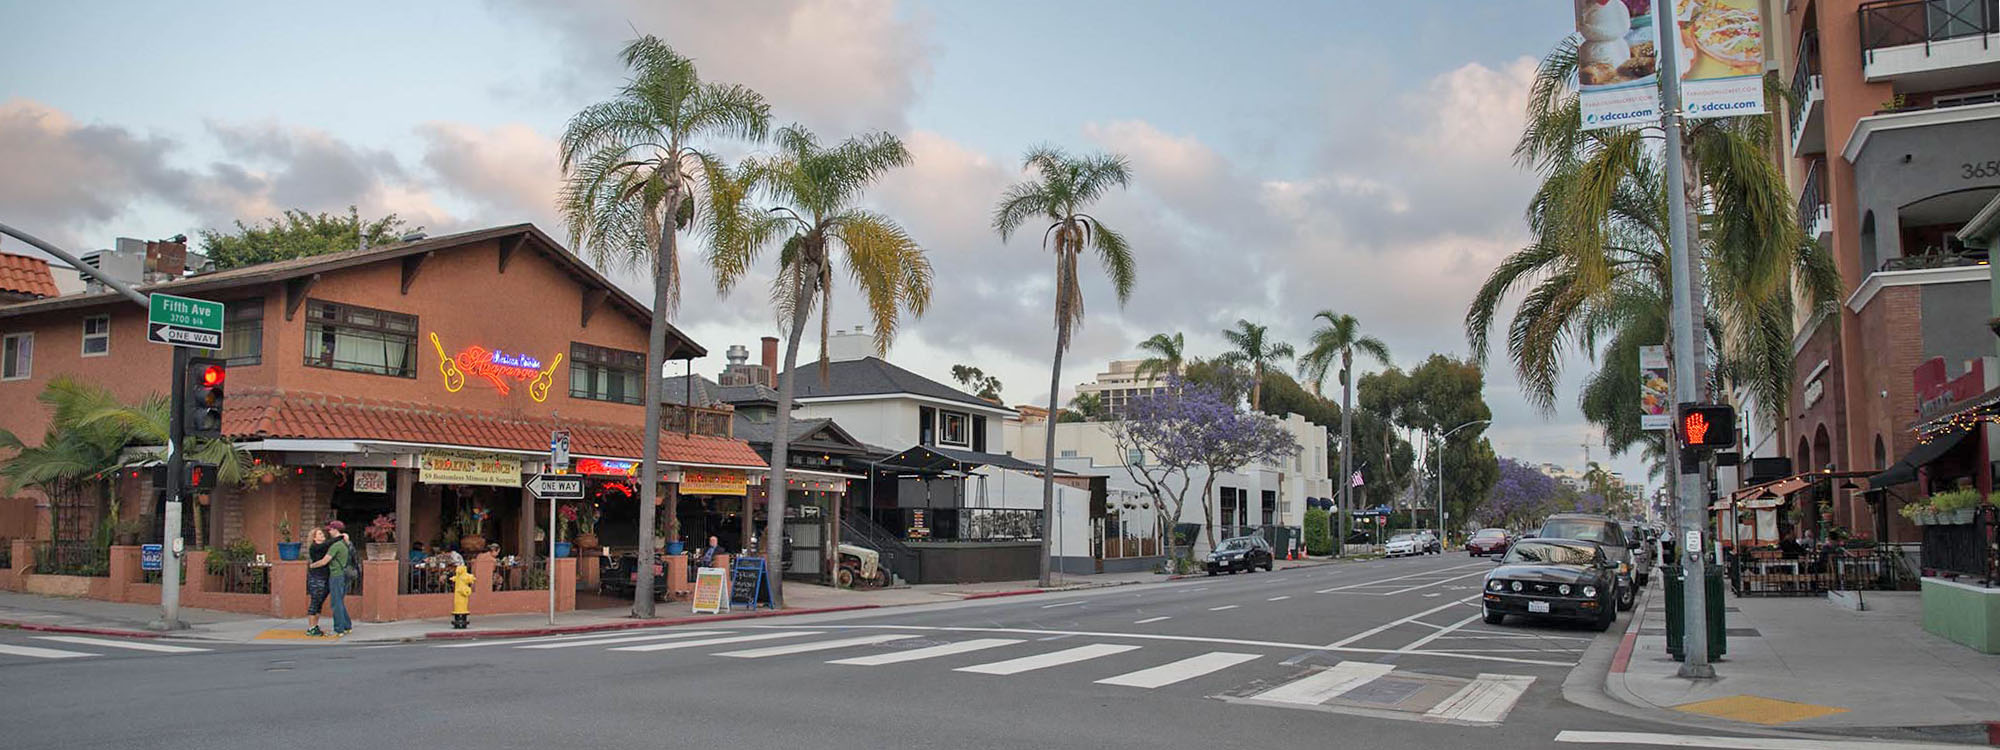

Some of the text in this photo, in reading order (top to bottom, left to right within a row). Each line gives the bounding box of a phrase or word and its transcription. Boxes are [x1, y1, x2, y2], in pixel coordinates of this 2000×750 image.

[1702, 100, 1756, 112] sdccu.com
[1600, 108, 1652, 122] sdccu.com
[1961, 160, 2000, 179] 365
[163, 299, 211, 317] Fifth Ave
[170, 313, 190, 324] 3700
[169, 330, 214, 343] ONE WAY
[541, 482, 577, 490] ONE WAY
